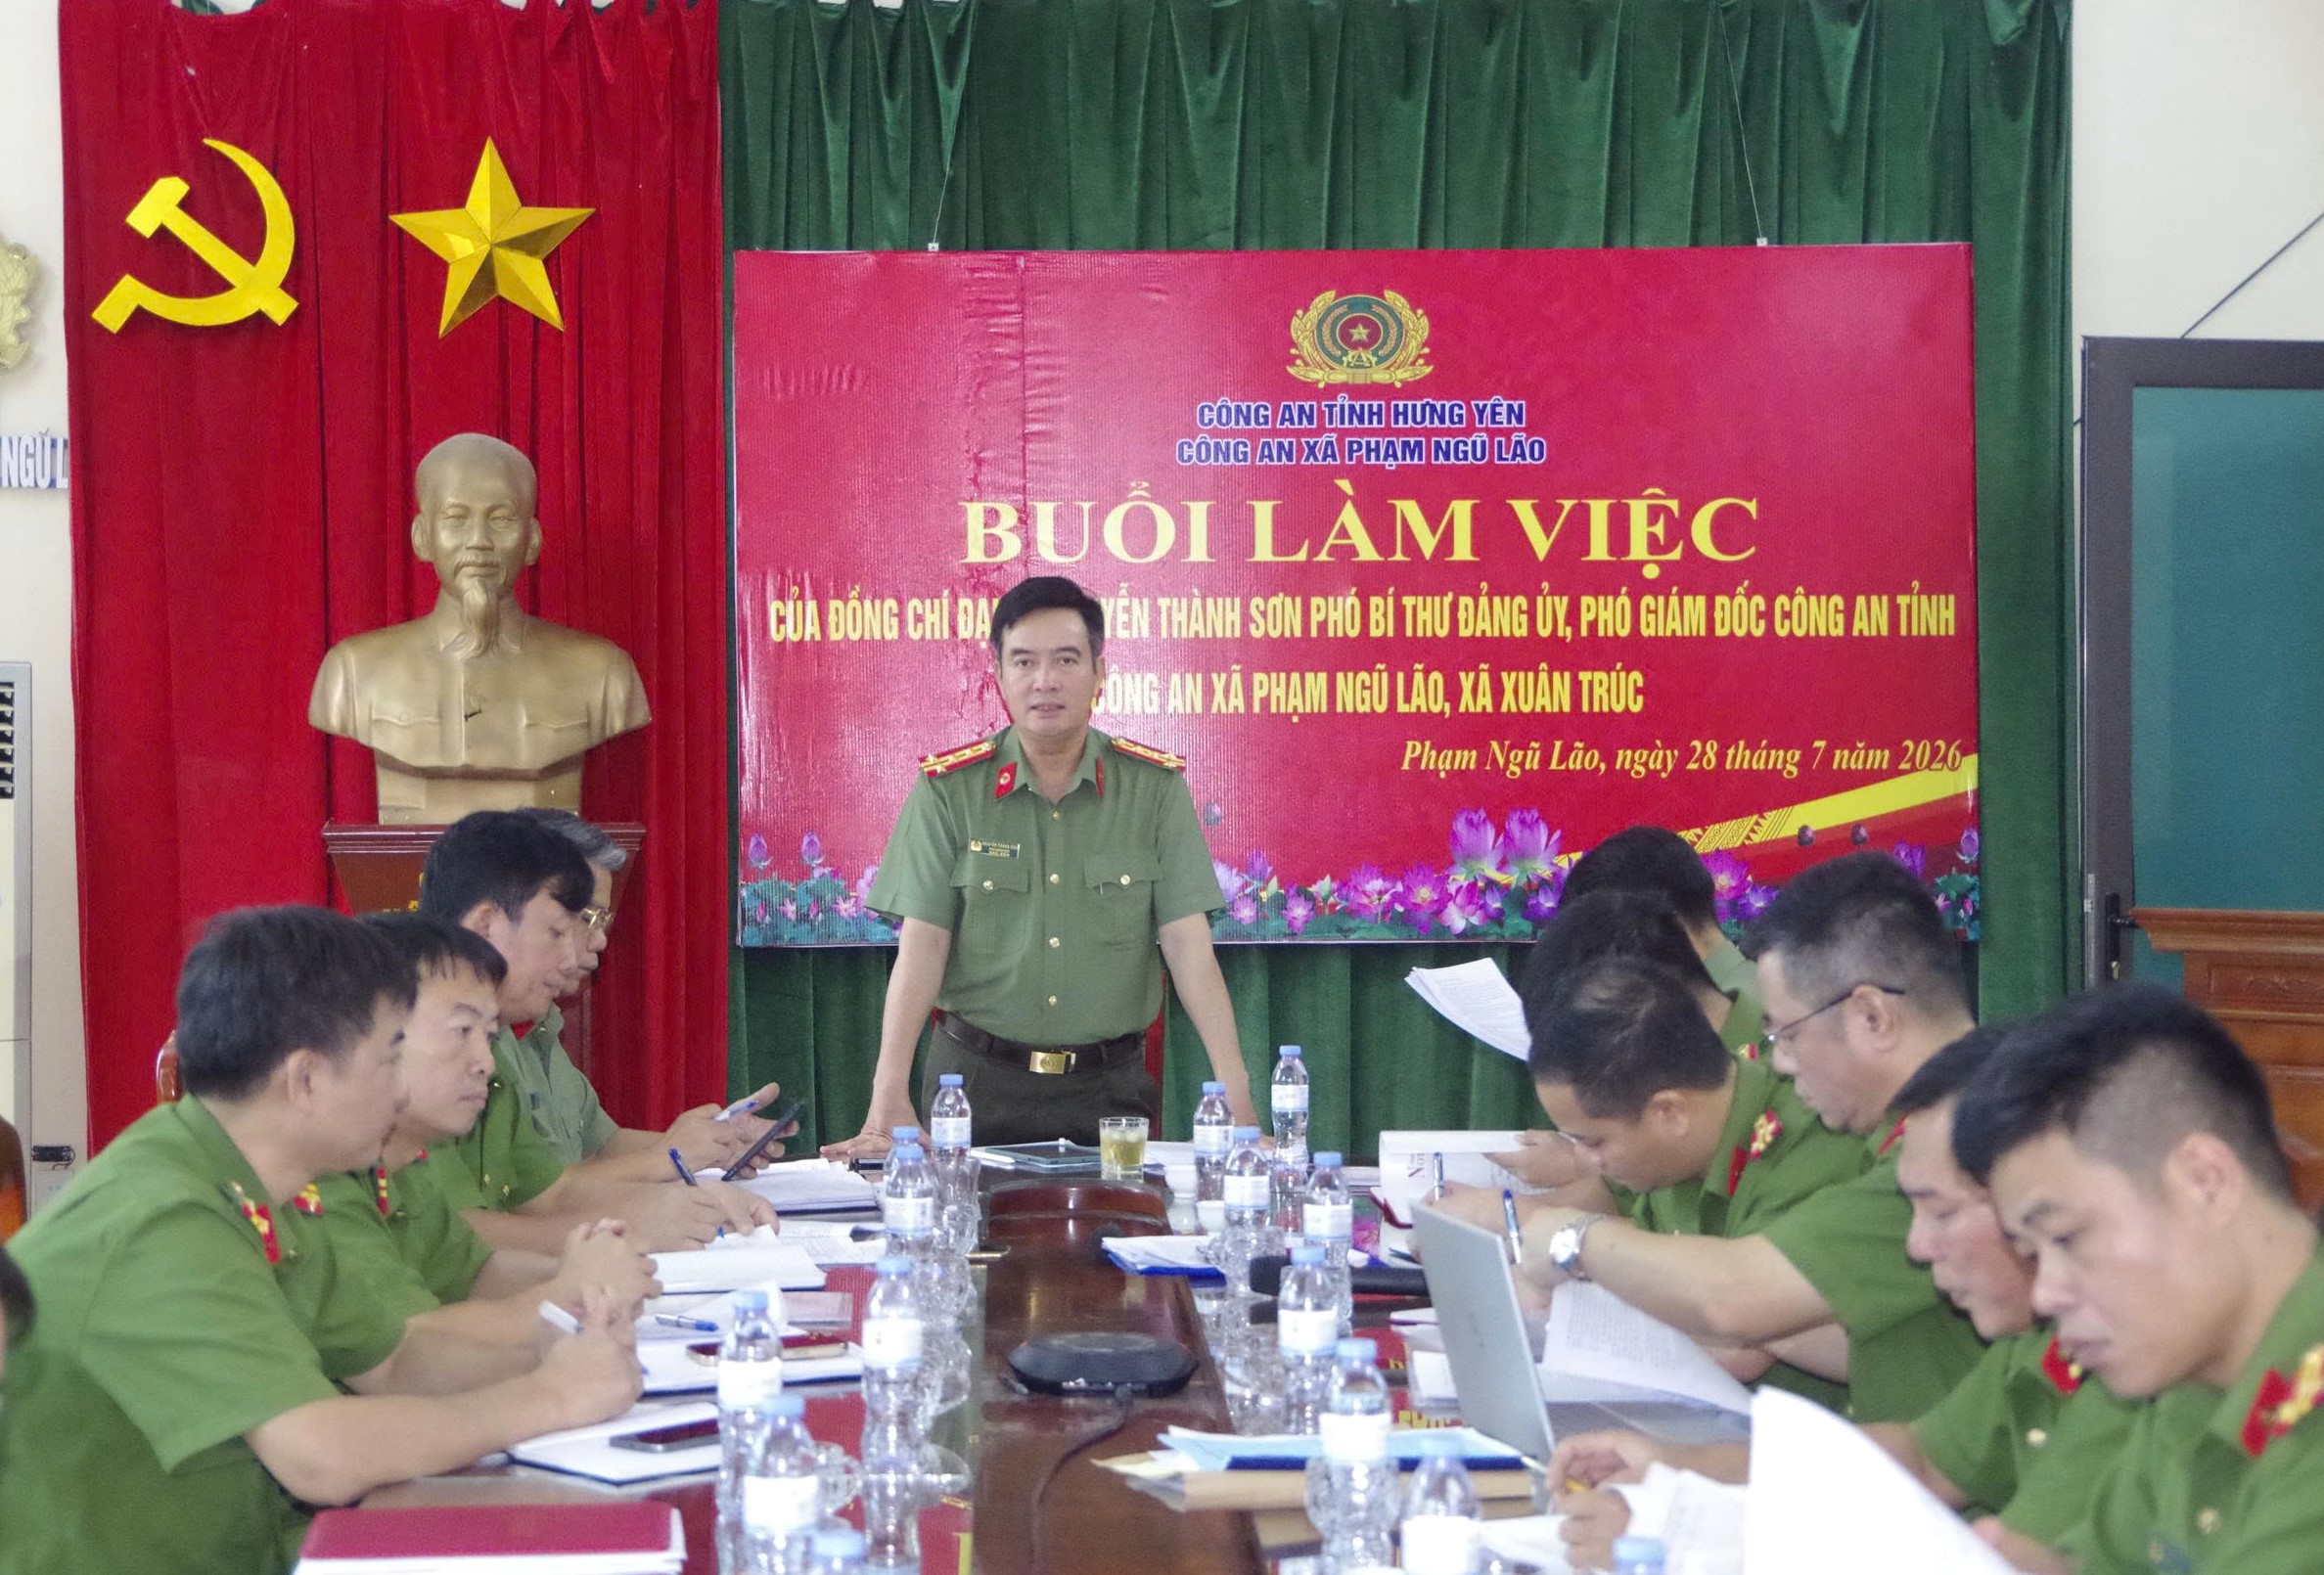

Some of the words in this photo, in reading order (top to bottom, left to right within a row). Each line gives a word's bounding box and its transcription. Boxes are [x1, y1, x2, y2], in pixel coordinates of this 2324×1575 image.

[1198, 398, 1271, 428] CÔNG
[1277, 402, 1316, 428] AN
[1322, 393, 1385, 428] TỈNH
[1391, 398, 1466, 428] HƯNG
[1472, 396, 1526, 428] YÊN
[1177, 434, 1250, 465] CÔNG
[1256, 438, 1296, 465] AN
[1301, 433, 1340, 465] XÃ
[1345, 438, 1425, 470] PHẠM
[1432, 433, 1488, 464] NGŨ
[1495, 432, 1546, 464] LÃO
[959, 481, 1216, 563] BUỔI
[1246, 479, 1481, 562] LÀM
[1505, 487, 1757, 579] VIỆC
[770, 586, 822, 642] CỦA
[829, 584, 899, 641] ĐỒNG
[907, 589, 949, 640] CHÍ
[957, 597, 1000, 649] ĐẠ
[1158, 588, 1241, 639] THÀNH
[1250, 592, 1301, 638] SƠN
[1310, 587, 1361, 638] PHÓ
[1369, 587, 1394, 637] BÍ
[1401, 591, 1453, 637] THƯ
[1457, 581, 1528, 637] ĐẢNG
[1536, 581, 1572, 643] ỦY,
[1580, 586, 1631, 637] PHÓ
[1640, 586, 1707, 637] GIÁM
[1714, 579, 1765, 637] ĐỐC
[1774, 586, 1845, 637] CÔNG
[1852, 594, 1889, 637] AN
[1896, 580, 1955, 637] TỈNH
[1168, 672, 1203, 713] AN
[1210, 664, 1245, 713] XÃ
[1253, 672, 1327, 723] PHẠM
[1336, 663, 1389, 713] NGŨ
[1396, 663, 1450, 718] LÃO,
[1458, 663, 1493, 713] XÃ
[1500, 662, 1571, 713] XUÂN
[1578, 662, 1644, 713] TRÚC
[1401, 741, 1478, 779] Phạm
[1484, 740, 1541, 779] Ngũ
[1548, 741, 1607, 776] Lão,
[1616, 740, 1678, 779] ngày
[1685, 740, 1718, 771] 28
[1725, 740, 1801, 779] tháng
[1811, 741, 1828, 771] 7
[1832, 742, 1890, 771] năm
[1898, 740, 1963, 772] 2026
